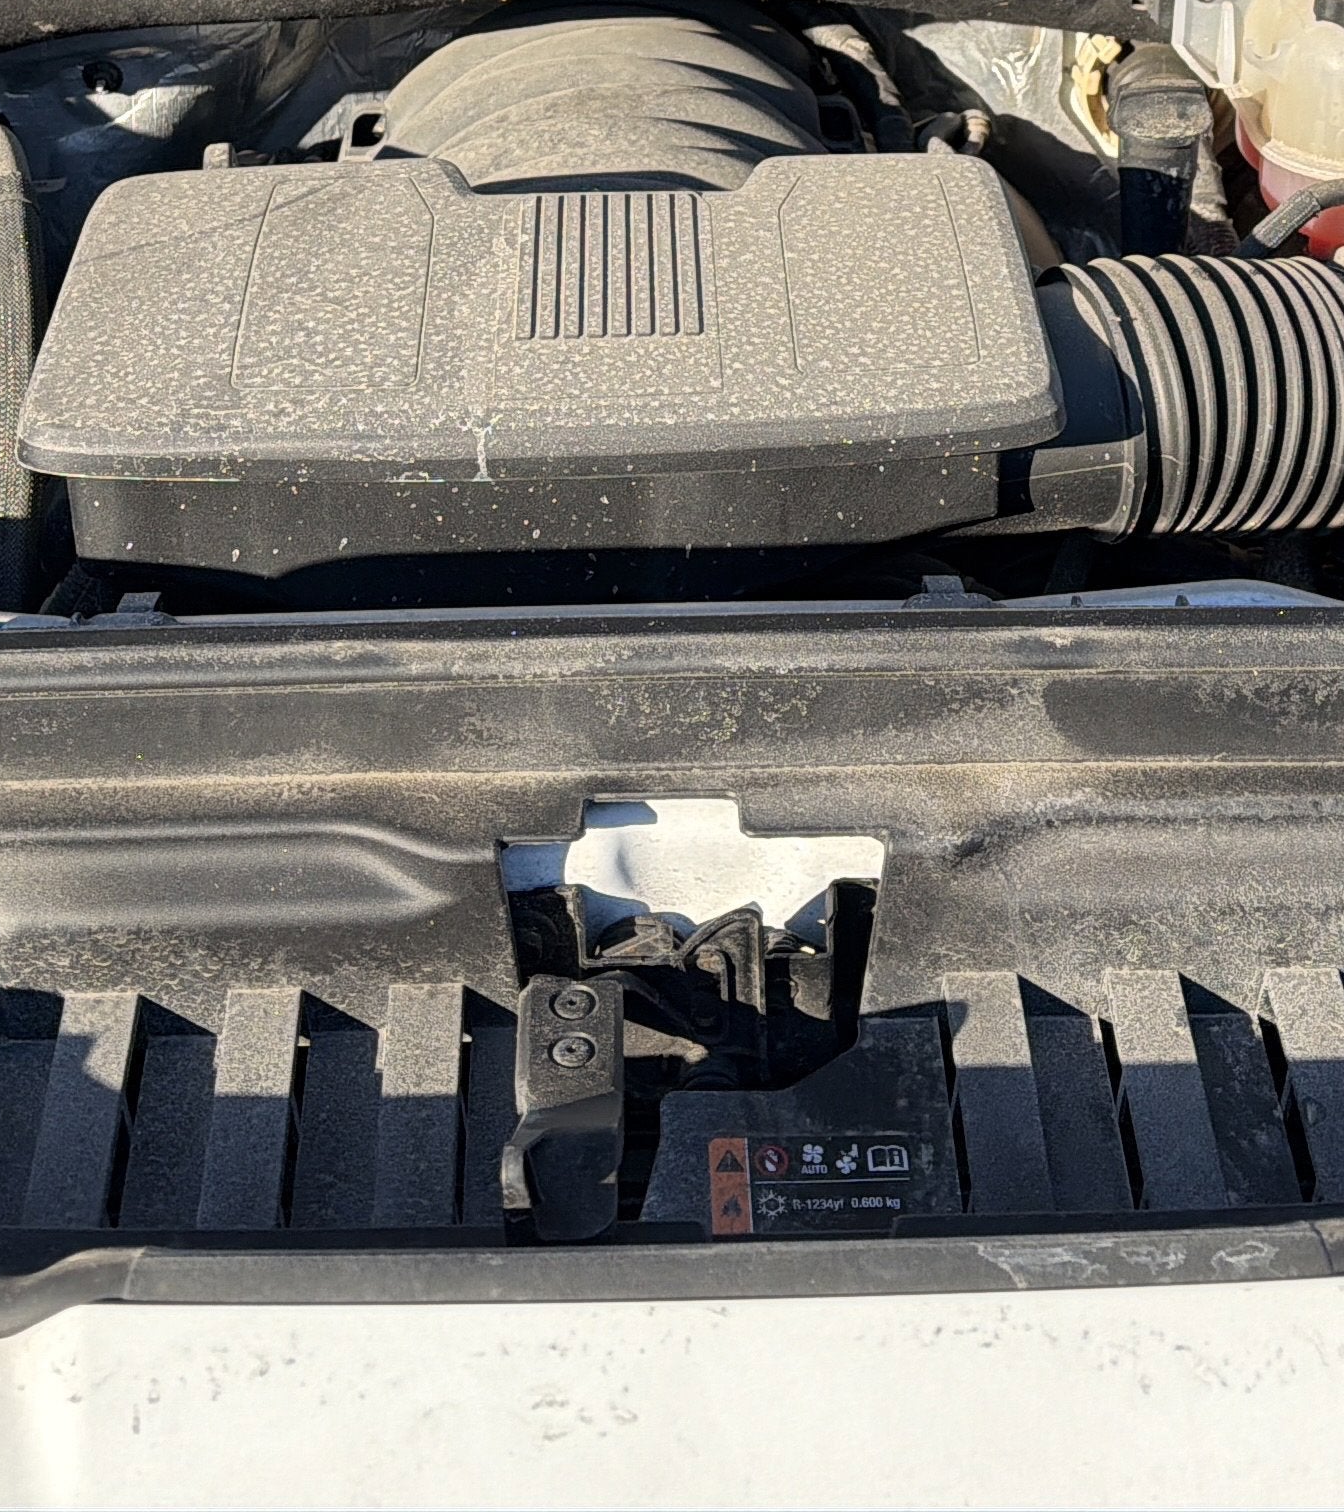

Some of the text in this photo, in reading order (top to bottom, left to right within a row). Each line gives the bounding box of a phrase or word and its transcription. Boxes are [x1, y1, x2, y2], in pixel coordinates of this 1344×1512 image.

[801, 1164, 828, 1175] AUTO
[792, 1196, 901, 1211] R-1234yf 0.600 kg
